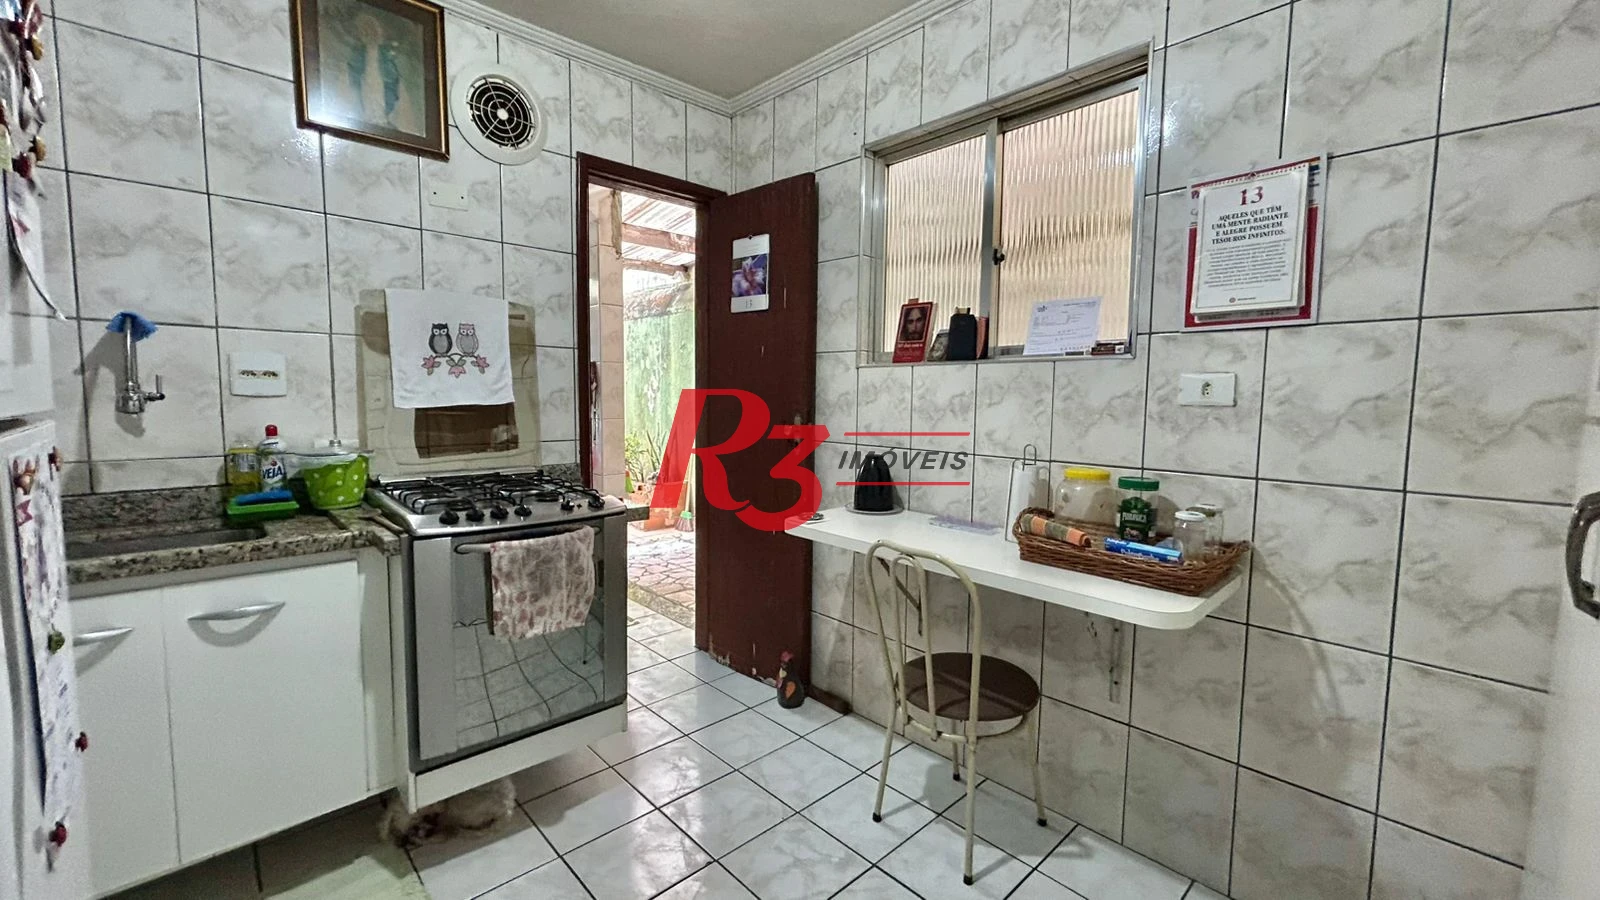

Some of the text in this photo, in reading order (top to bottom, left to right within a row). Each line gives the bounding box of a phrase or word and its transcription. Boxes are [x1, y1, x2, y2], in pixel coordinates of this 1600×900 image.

[1240, 186, 1264, 206] 13
[1211, 211, 1289, 230] UMA MENTE RADIANTE
[1218, 211, 1249, 222] AQUELES
[1250, 207, 1265, 218] QUE
[1221, 226, 1248, 236] ALEGRE
[1249, 221, 1283, 232] POSSUEM
[1212, 234, 1247, 245] TESOUROS
